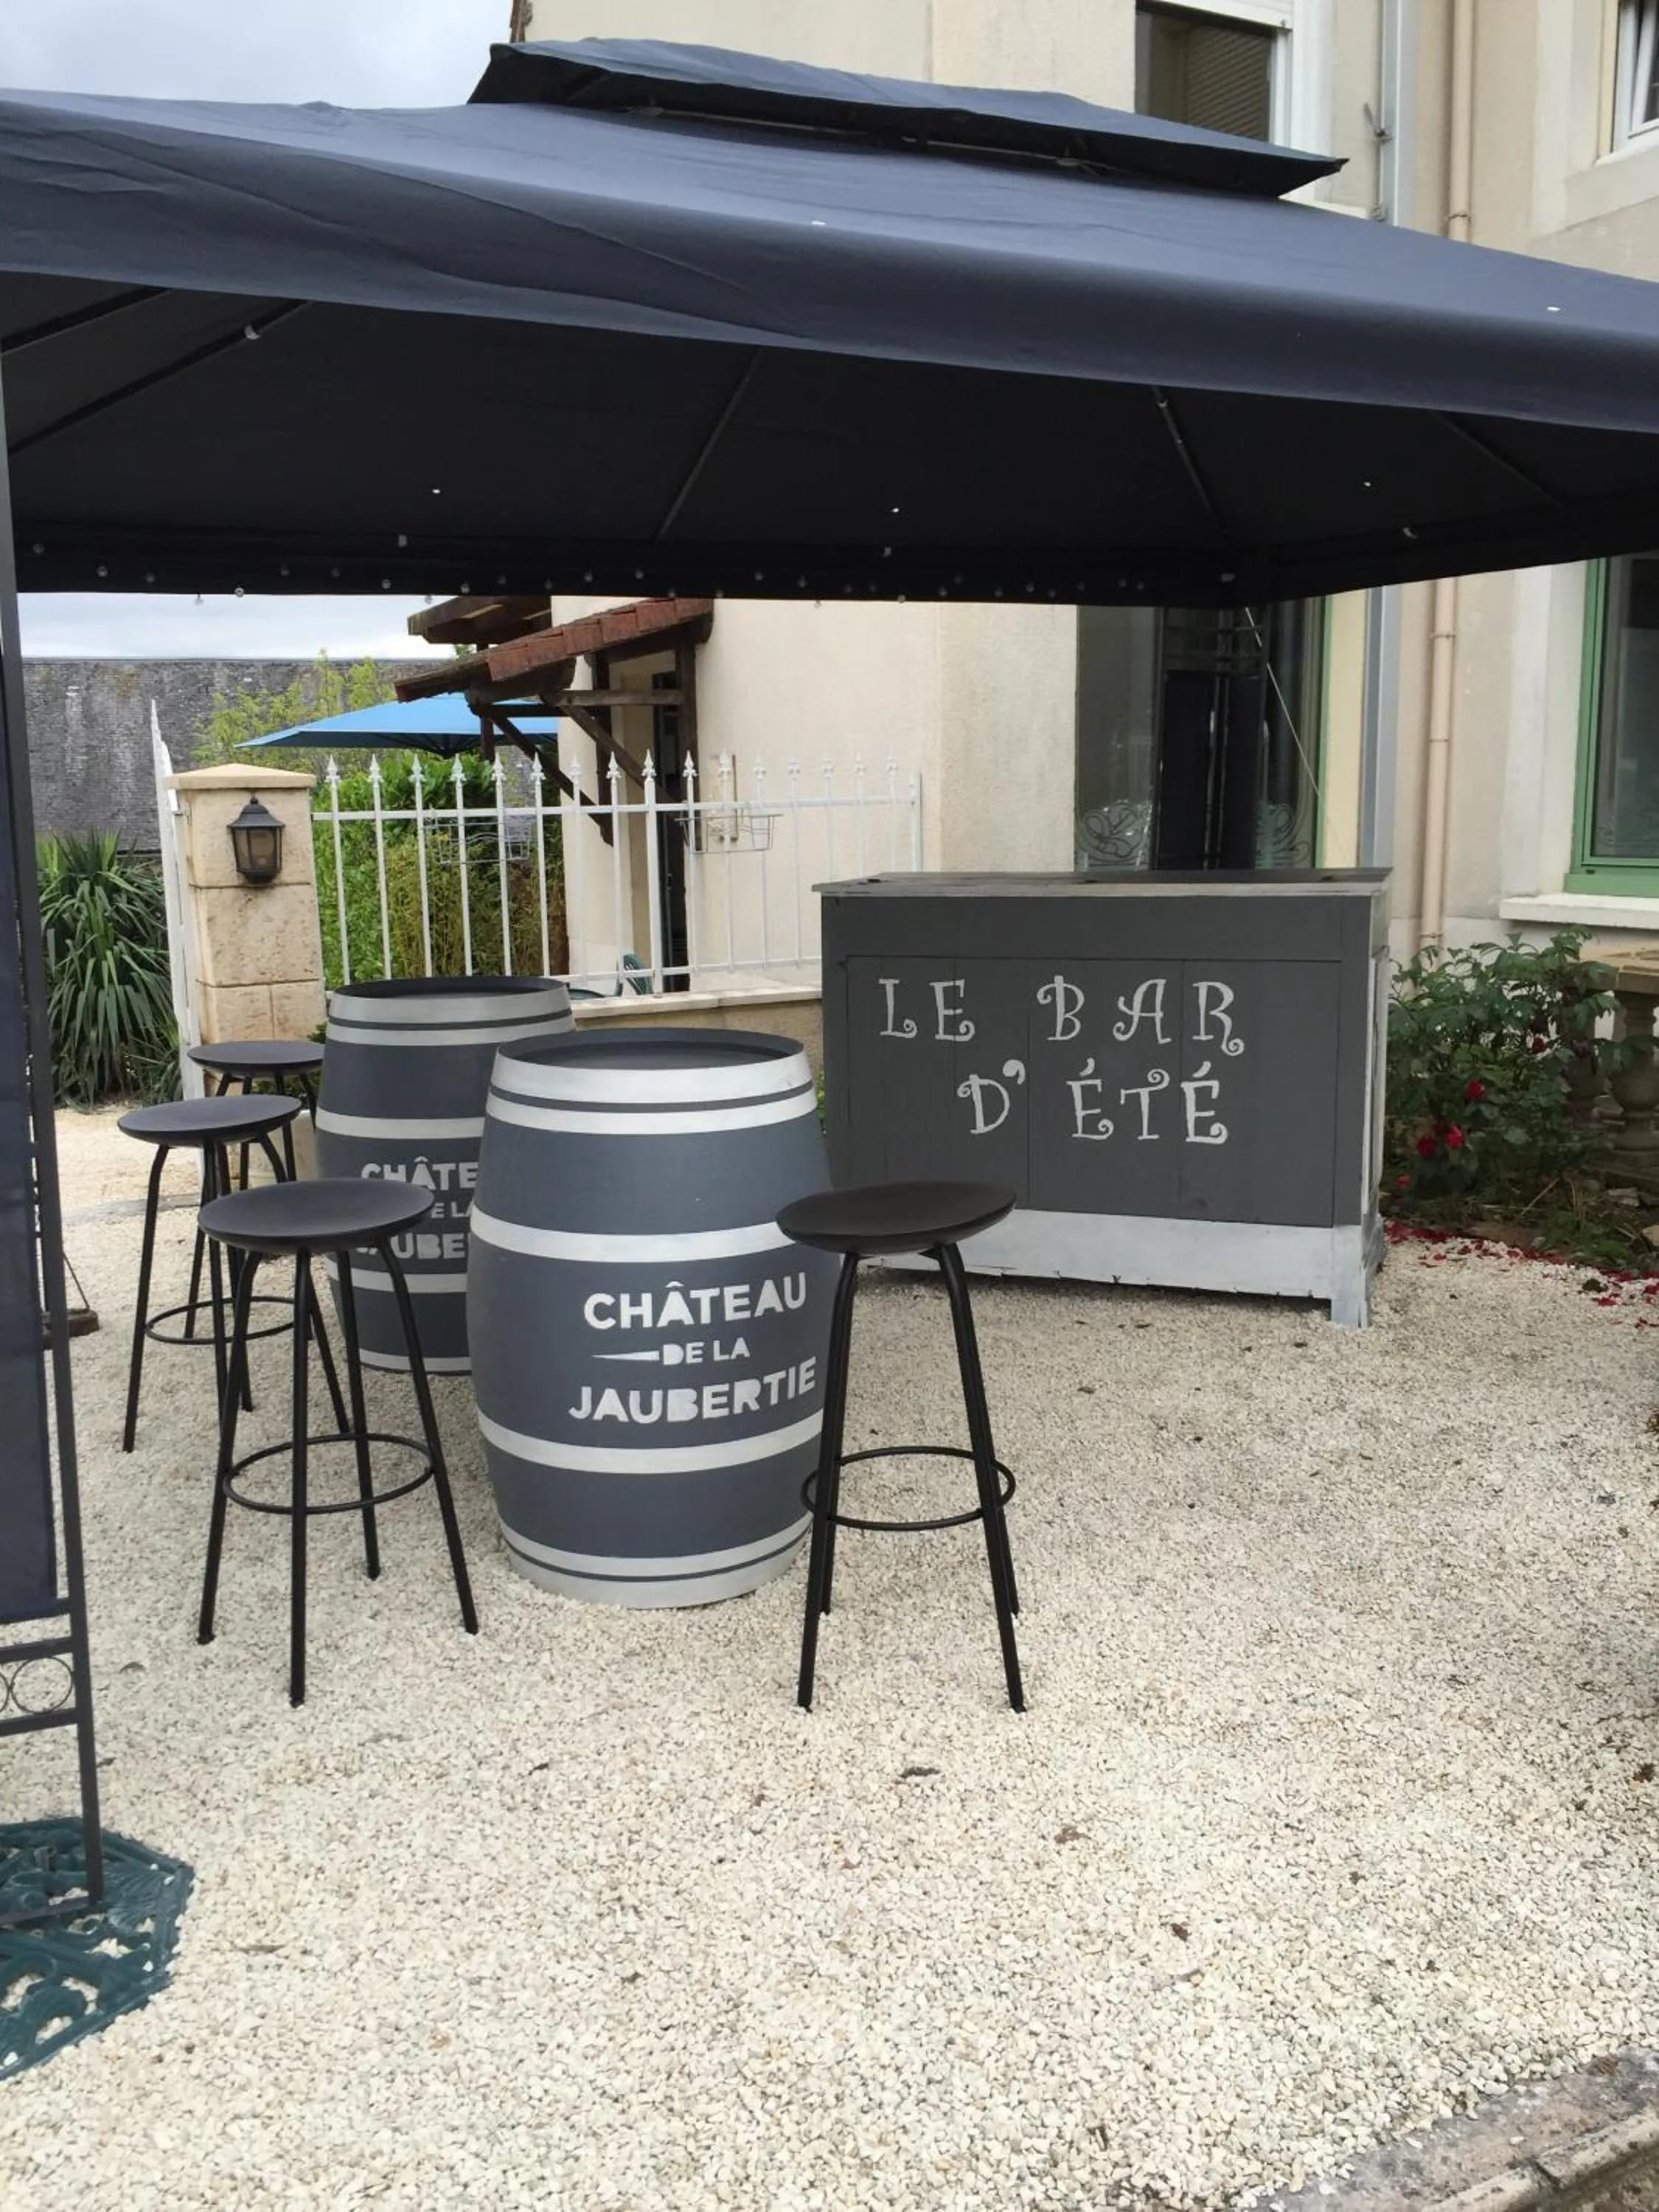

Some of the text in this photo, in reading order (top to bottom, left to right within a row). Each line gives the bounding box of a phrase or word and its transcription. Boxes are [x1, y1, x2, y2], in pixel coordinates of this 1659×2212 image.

[879, 975, 1245, 1056] LE BAR
[583, 1272, 806, 1330] CHÂTEAU
[663, 1337, 751, 1366] DE LA
[568, 1357, 817, 1425] JAUBERTIE
